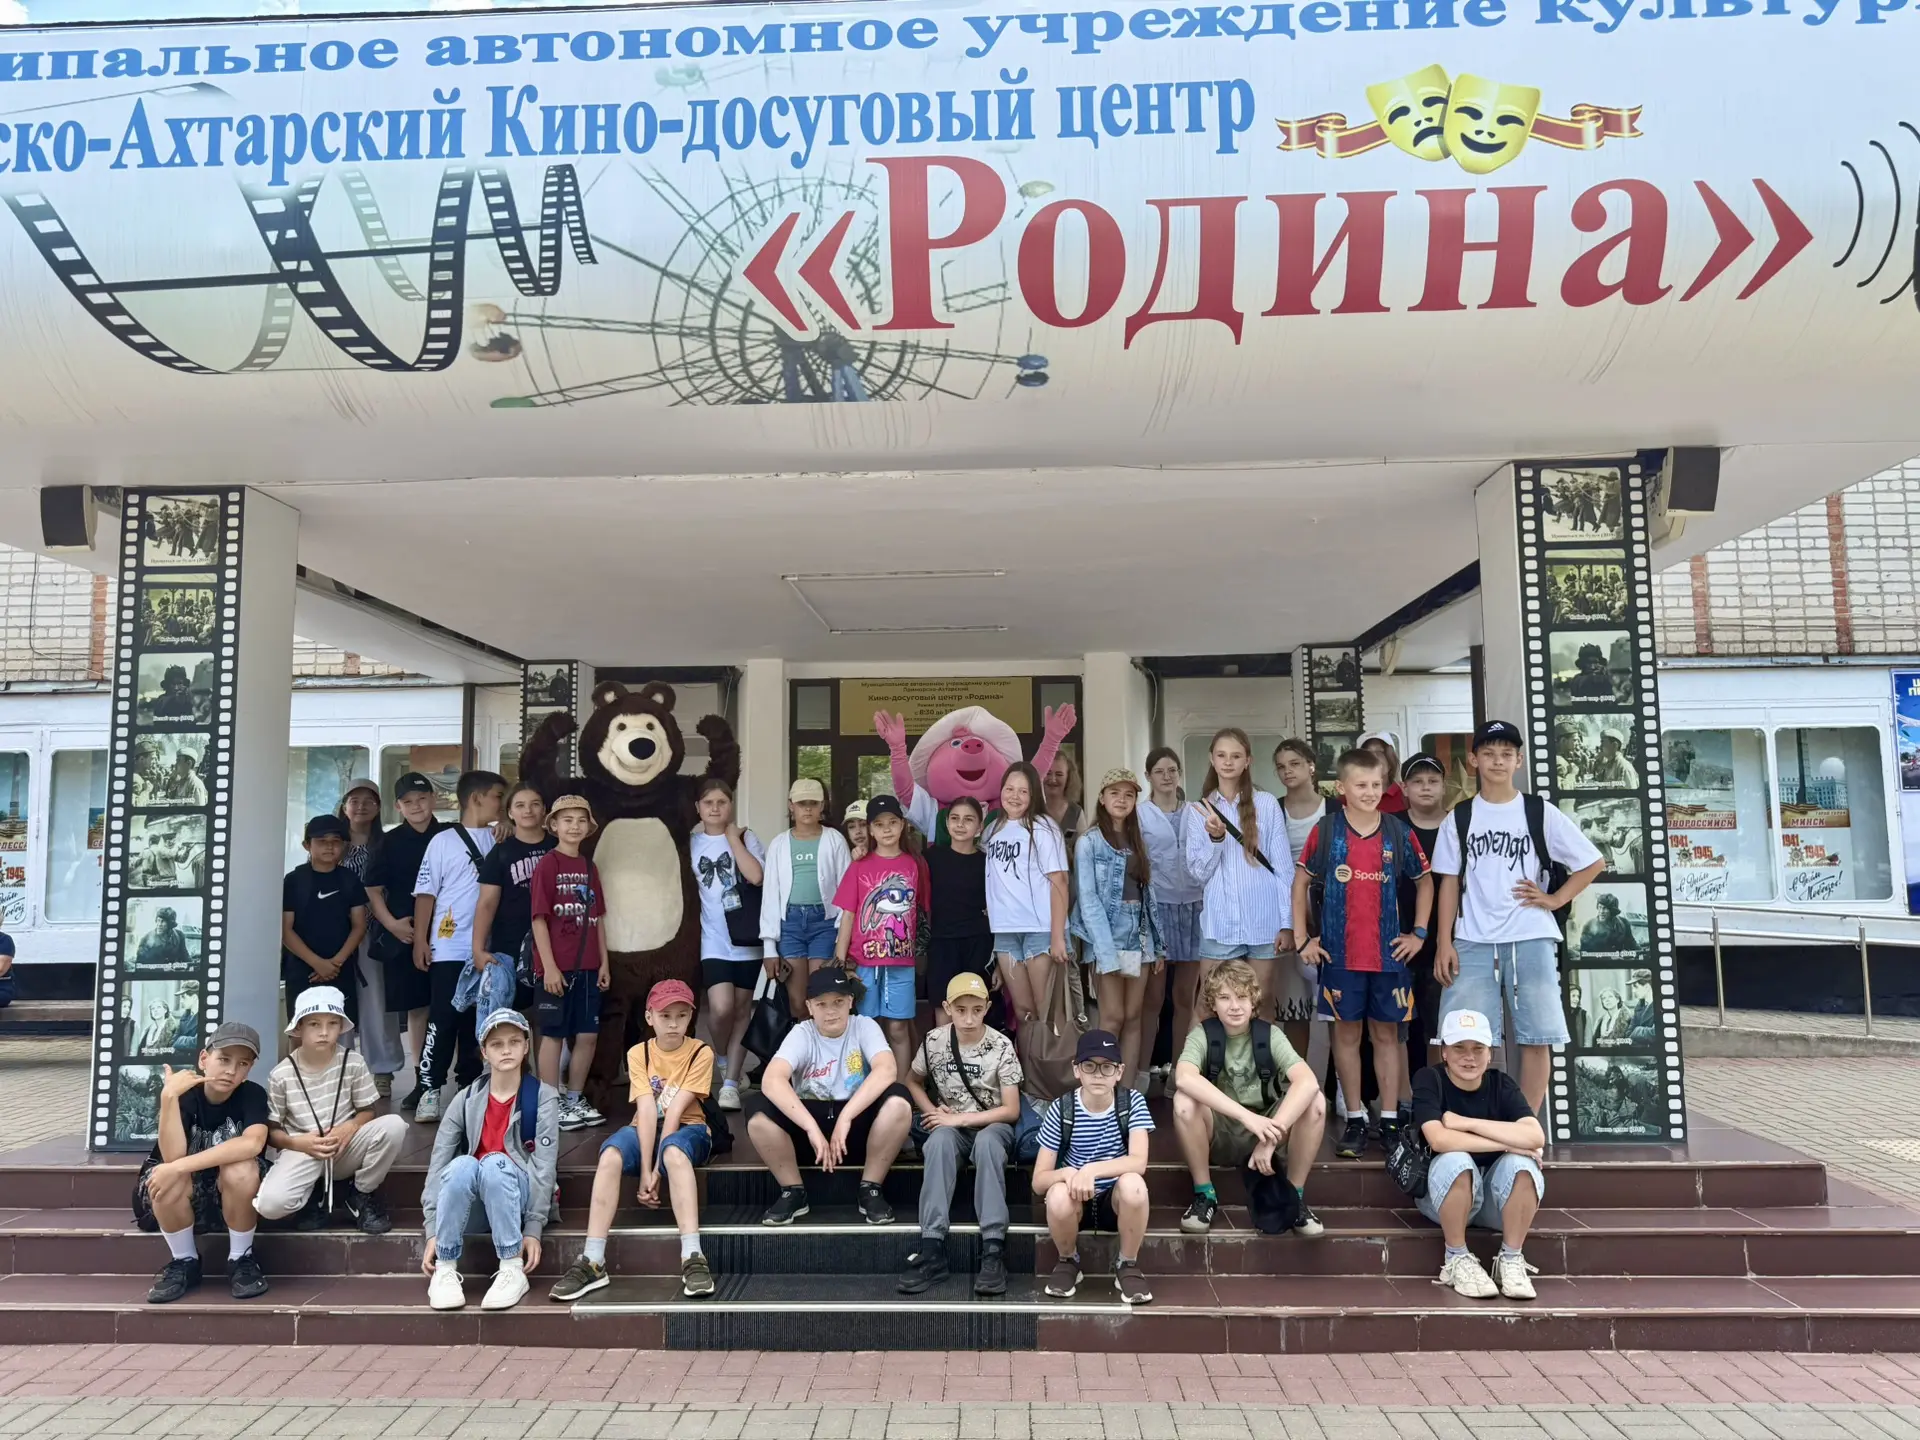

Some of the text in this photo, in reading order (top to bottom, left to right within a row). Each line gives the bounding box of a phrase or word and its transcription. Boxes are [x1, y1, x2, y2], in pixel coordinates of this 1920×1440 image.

[427, 17, 938, 67] автономное
[964, 0, 1506, 58] учреждение
[1536, 0, 1920, 33] культур
[487, 68, 1035, 169] Кино-досуговый
[1056, 79, 1255, 155] центр
[744, 157, 1812, 349] «Родина»
[868, 694, 936, 702] Кино-досуговый
[938, 694, 963, 702] центр
[1791, 818, 1825, 826] МИНСК
[1693, 845, 1713, 859] 1945
[1804, 845, 1826, 858] 1945
[556, 873, 588, 884] BEYON
[1354, 869, 1390, 884] Spotify
[963, 1065, 978, 1073] MITS
